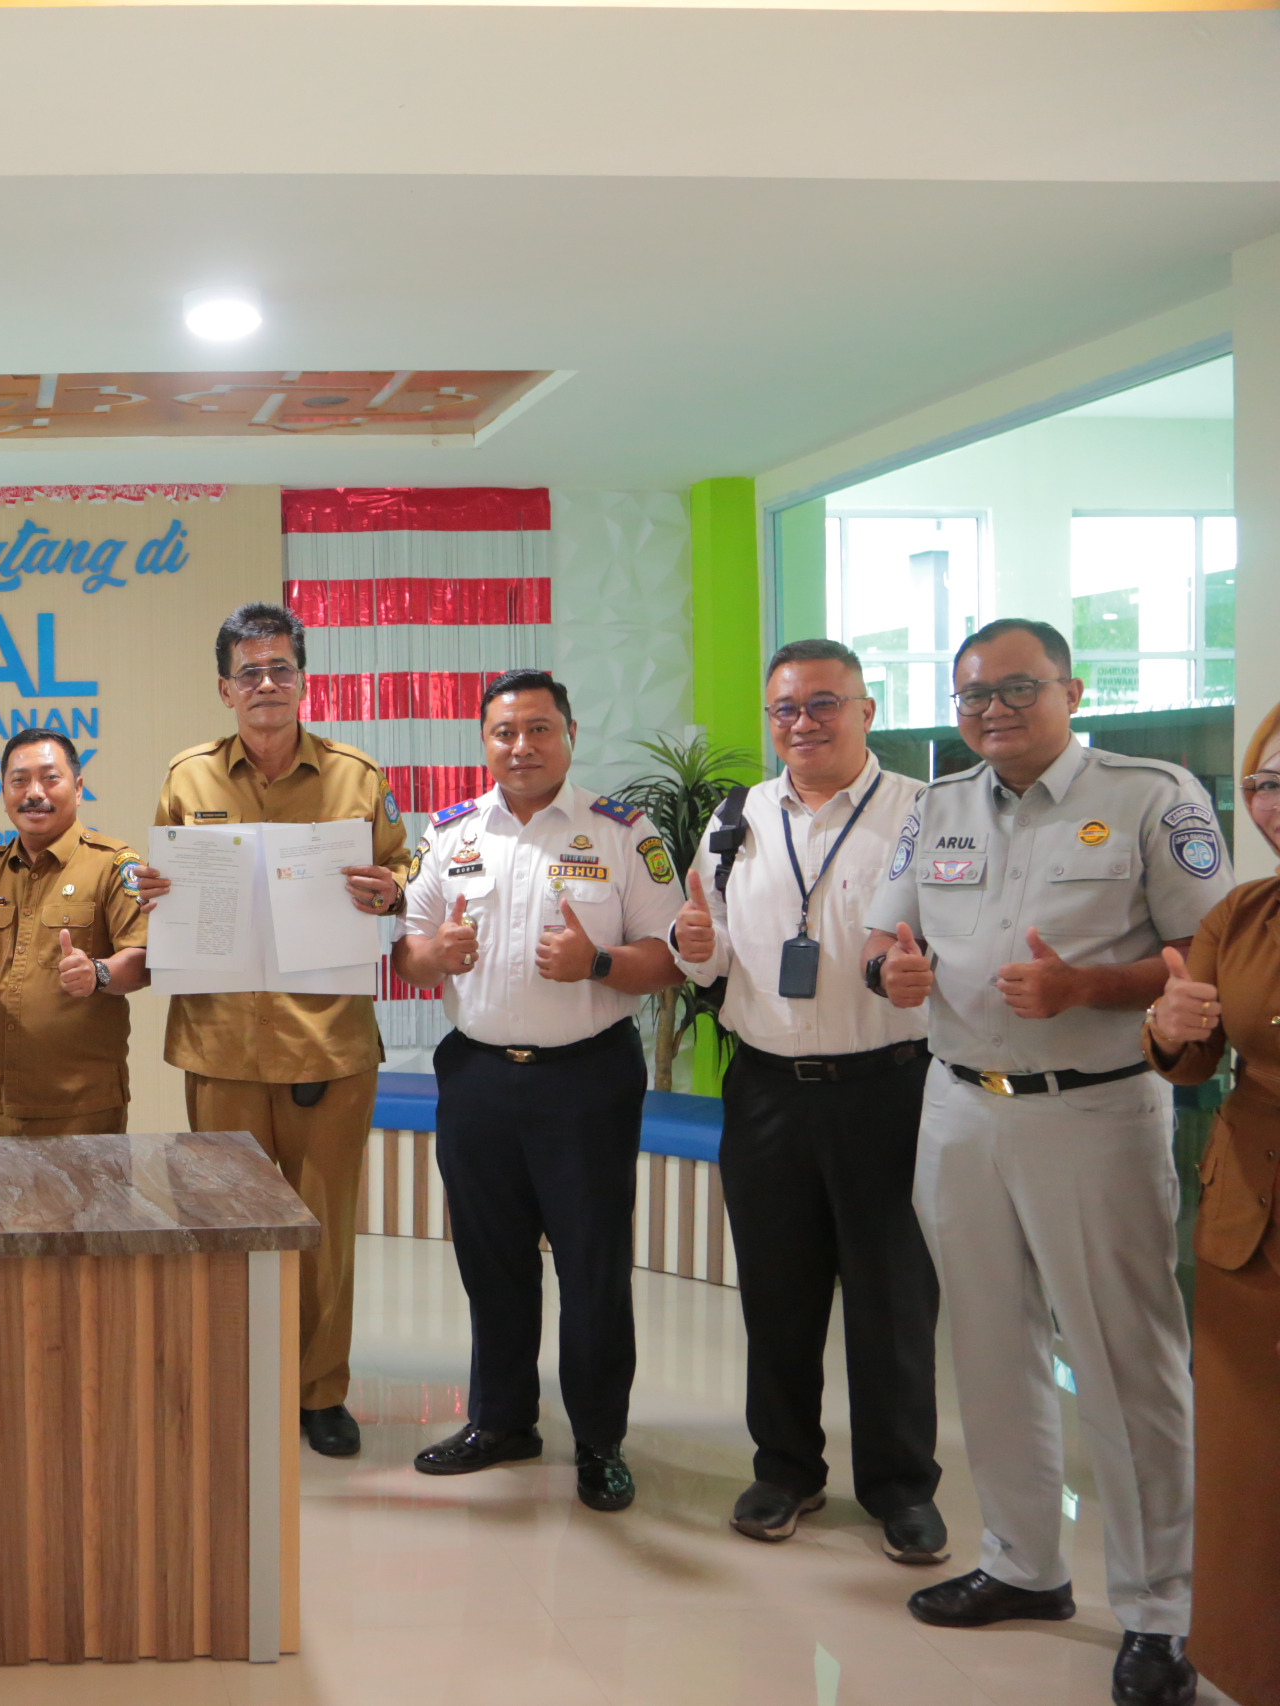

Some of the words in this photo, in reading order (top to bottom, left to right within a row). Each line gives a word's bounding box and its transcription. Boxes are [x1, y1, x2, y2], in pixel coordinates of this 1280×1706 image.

[135, 519, 190, 575] di
[935, 836, 977, 849] ARUL
[456, 866, 475, 874] BOBY
[551, 866, 606, 878] DISHUB
